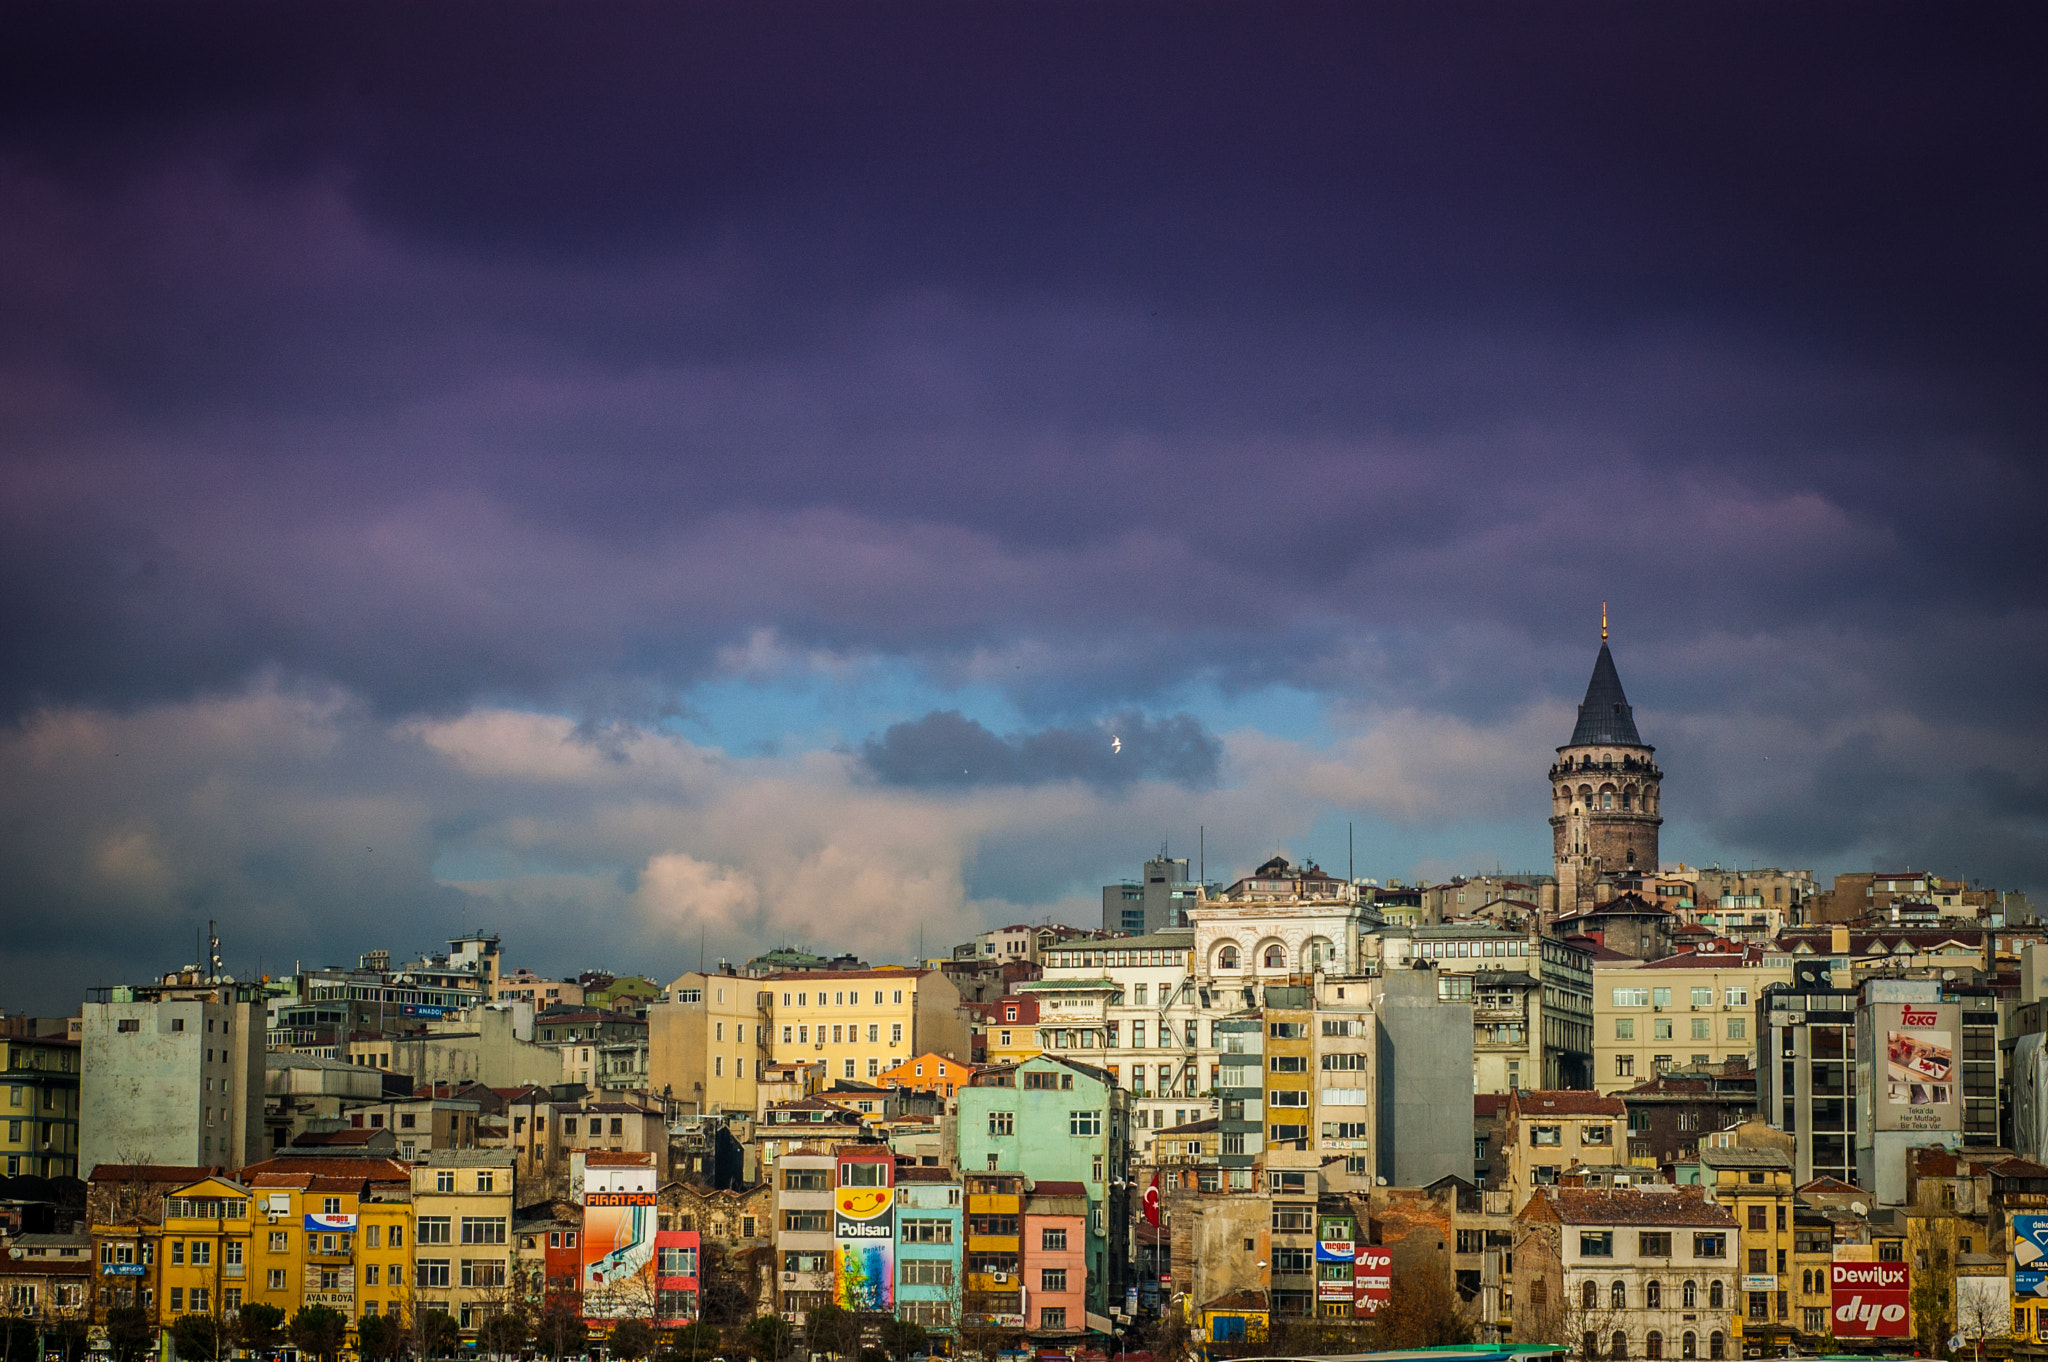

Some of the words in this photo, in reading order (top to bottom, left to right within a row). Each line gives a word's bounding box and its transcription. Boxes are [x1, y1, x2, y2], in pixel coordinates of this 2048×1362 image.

[1908, 1107, 1934, 1115] Teka'da
[1914, 1115, 1942, 1123] Mutfağa
[587, 1194, 656, 1206] FIRATPEN
[838, 1222, 890, 1236] Polisan
[1355, 1252, 1390, 1269] dyo
[1834, 1266, 1904, 1286] Dewilux
[306, 1294, 328, 1302] AYAN
[331, 1294, 353, 1302] BOYA
[1836, 1296, 1905, 1330] dyo
